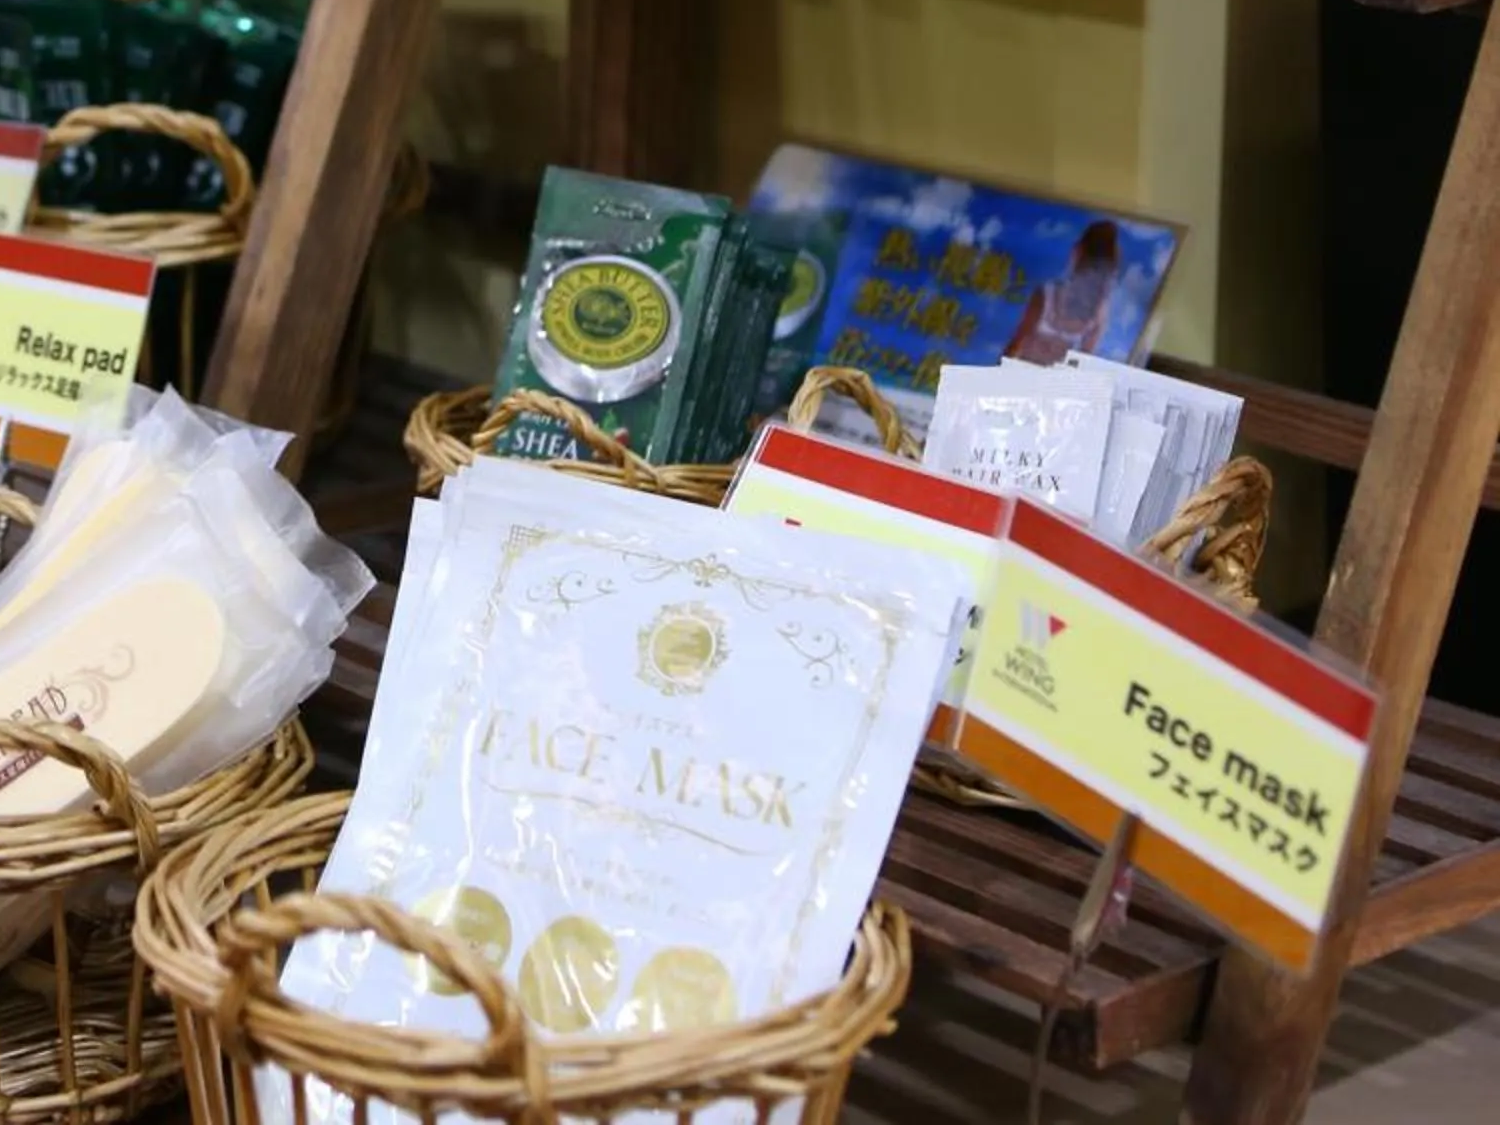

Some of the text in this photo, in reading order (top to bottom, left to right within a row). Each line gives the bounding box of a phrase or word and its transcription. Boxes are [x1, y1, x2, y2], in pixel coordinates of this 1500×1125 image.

[15, 323, 128, 375] Relax pad
[512, 426, 579, 460] SHEA
[969, 446, 1049, 468] MILKY
[1004, 651, 1055, 696] WING
[479, 709, 807, 829] FACE MASK
[1122, 679, 1334, 838] Face mask
[1146, 751, 1322, 876] フェイスマスク
